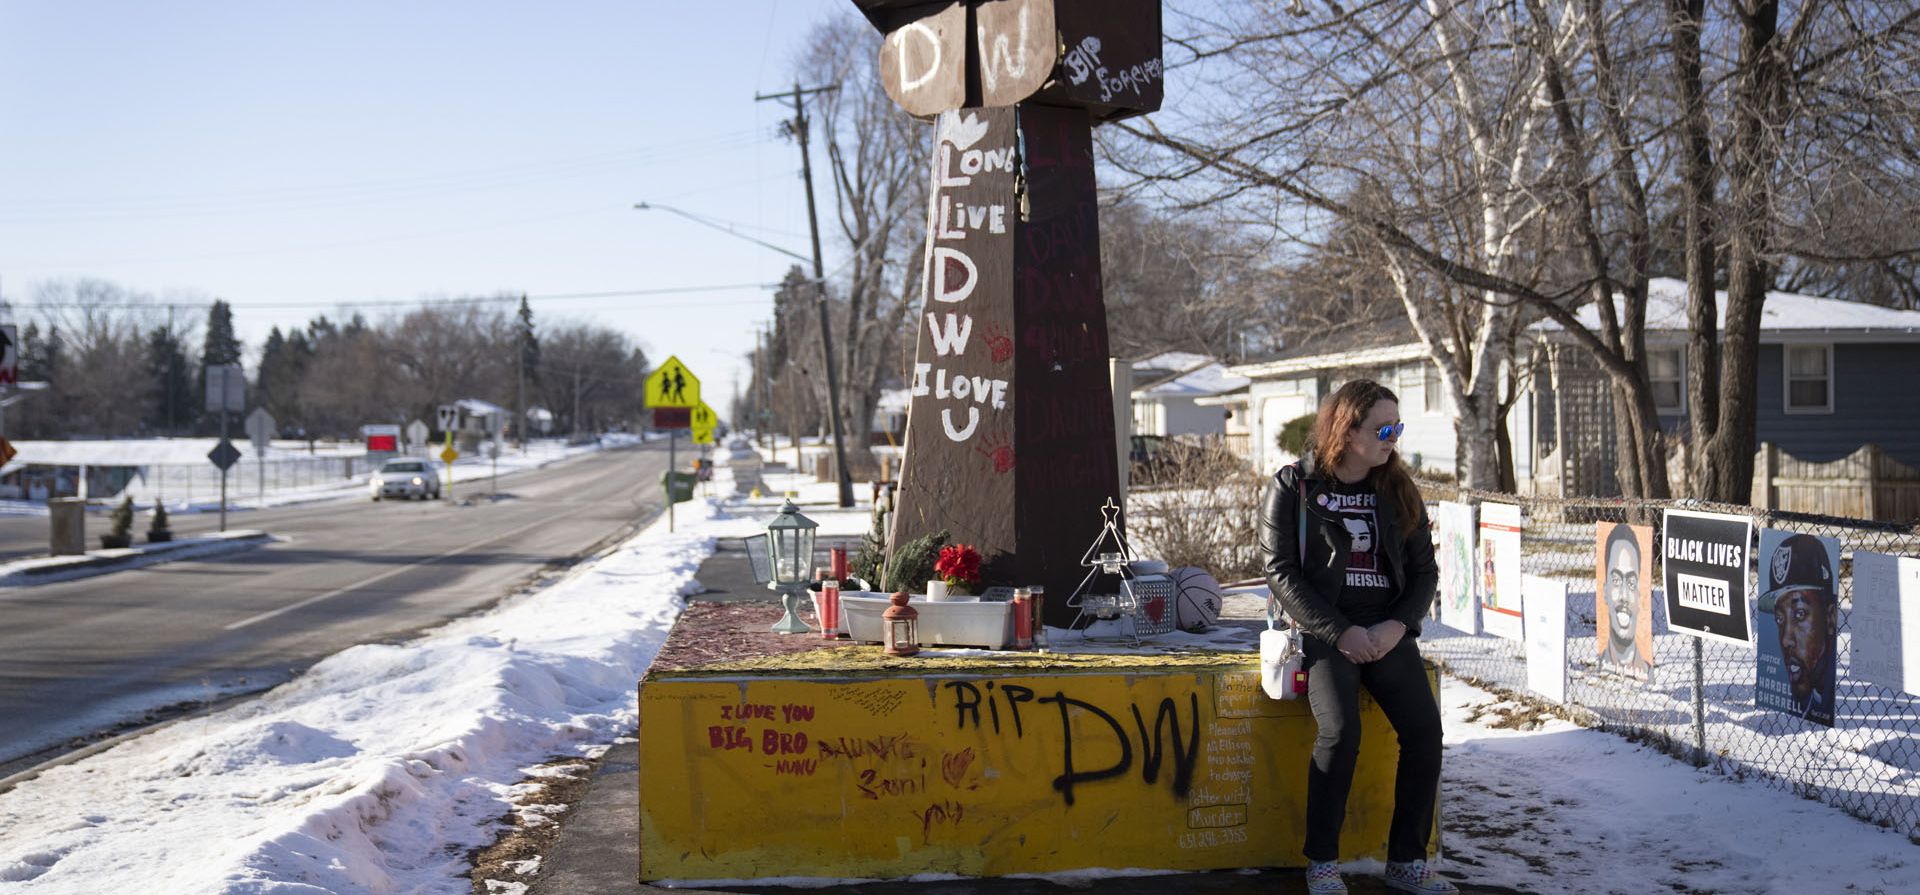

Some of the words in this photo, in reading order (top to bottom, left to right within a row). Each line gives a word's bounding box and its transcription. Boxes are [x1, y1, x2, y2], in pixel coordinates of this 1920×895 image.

[893, 22, 942, 94] D
[977, 4, 1029, 94] W
[940, 144, 1015, 187] LONG
[934, 247, 978, 303] D
[926, 311, 973, 357] W
[912, 363, 932, 397] I
[935, 369, 1008, 411] LOVE
[941, 406, 980, 442] U
[1364, 494, 1377, 508] FO
[1667, 537, 1703, 563] BLACK
[1707, 542, 1742, 568] LIVES
[1682, 581, 1726, 608] MATTER
[1758, 676, 1793, 696] HARDEL
[1758, 690, 1803, 713] SHERRELL
[721, 705, 732, 720] I
[735, 704, 776, 722] LOVE
[782, 703, 815, 724] YOU
[708, 726, 753, 753] BIG
[762, 729, 808, 755] BRO
[1038, 691, 1200, 806] DW
